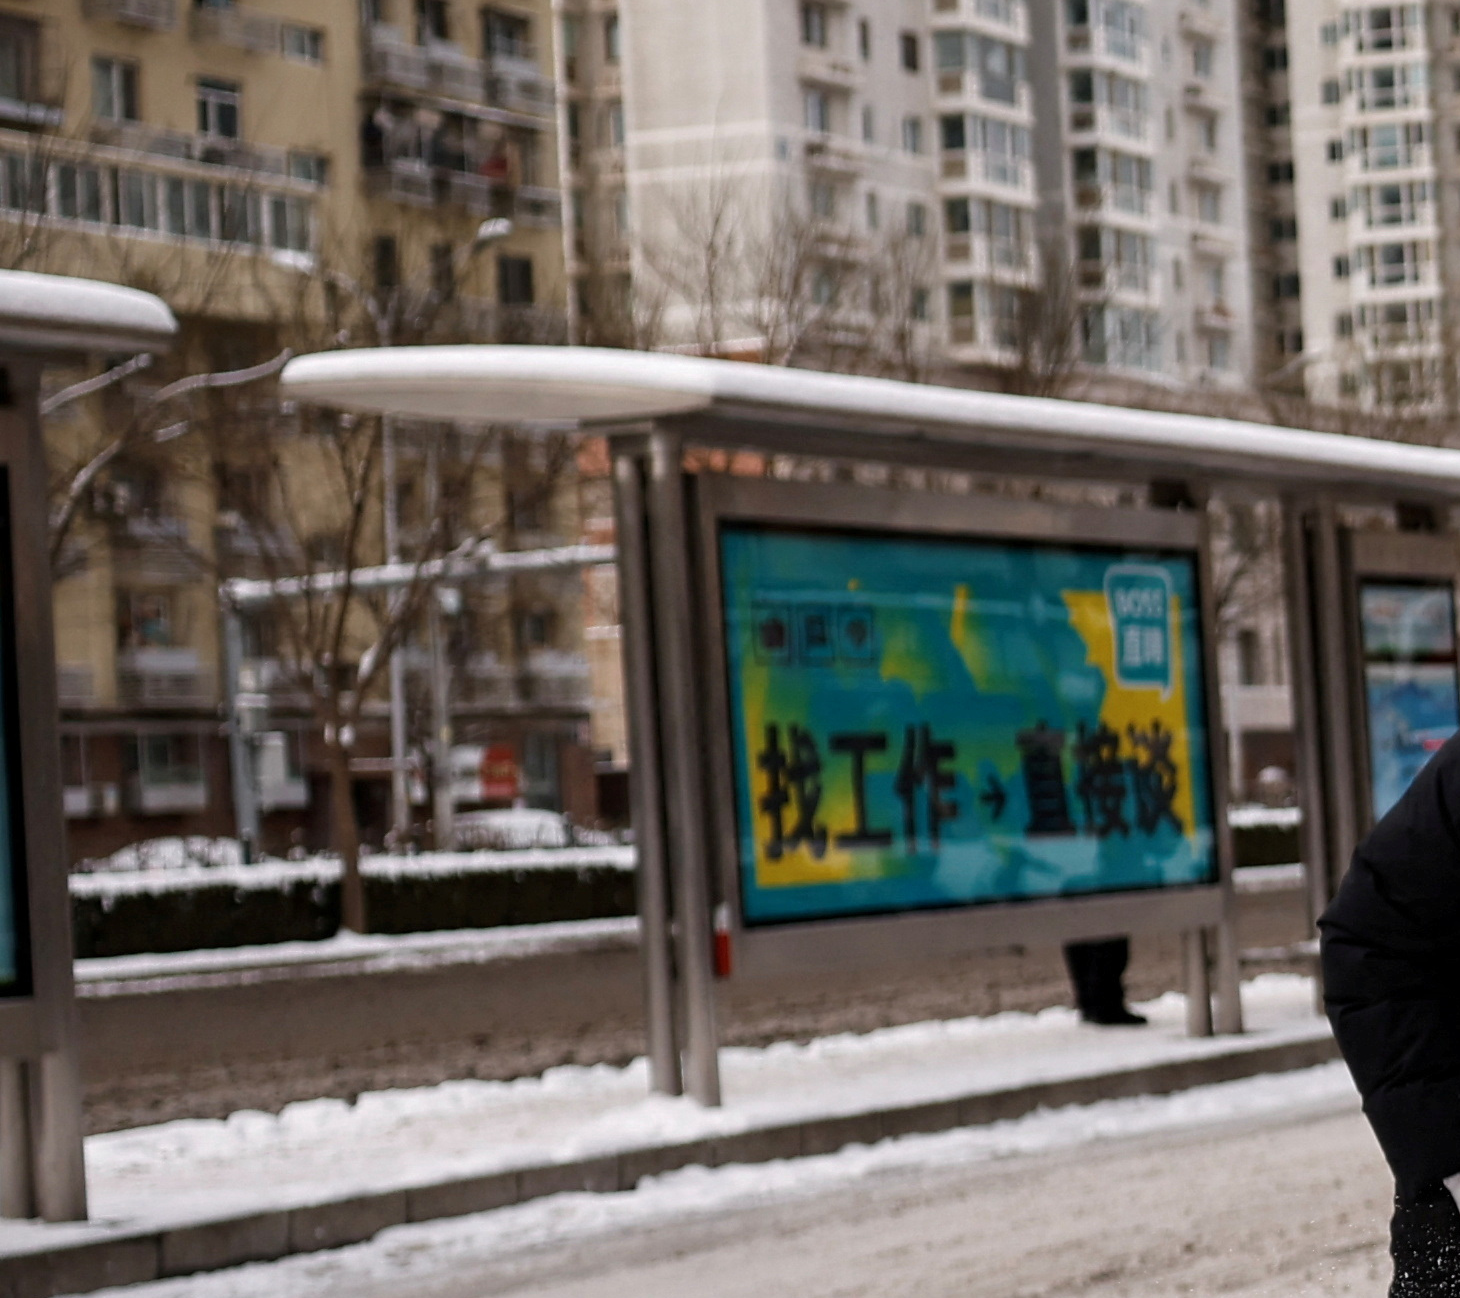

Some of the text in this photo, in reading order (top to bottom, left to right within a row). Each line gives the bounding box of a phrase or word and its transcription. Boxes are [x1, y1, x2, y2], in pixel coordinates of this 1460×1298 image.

[759, 718, 1183, 860] 找工作 直接谈
